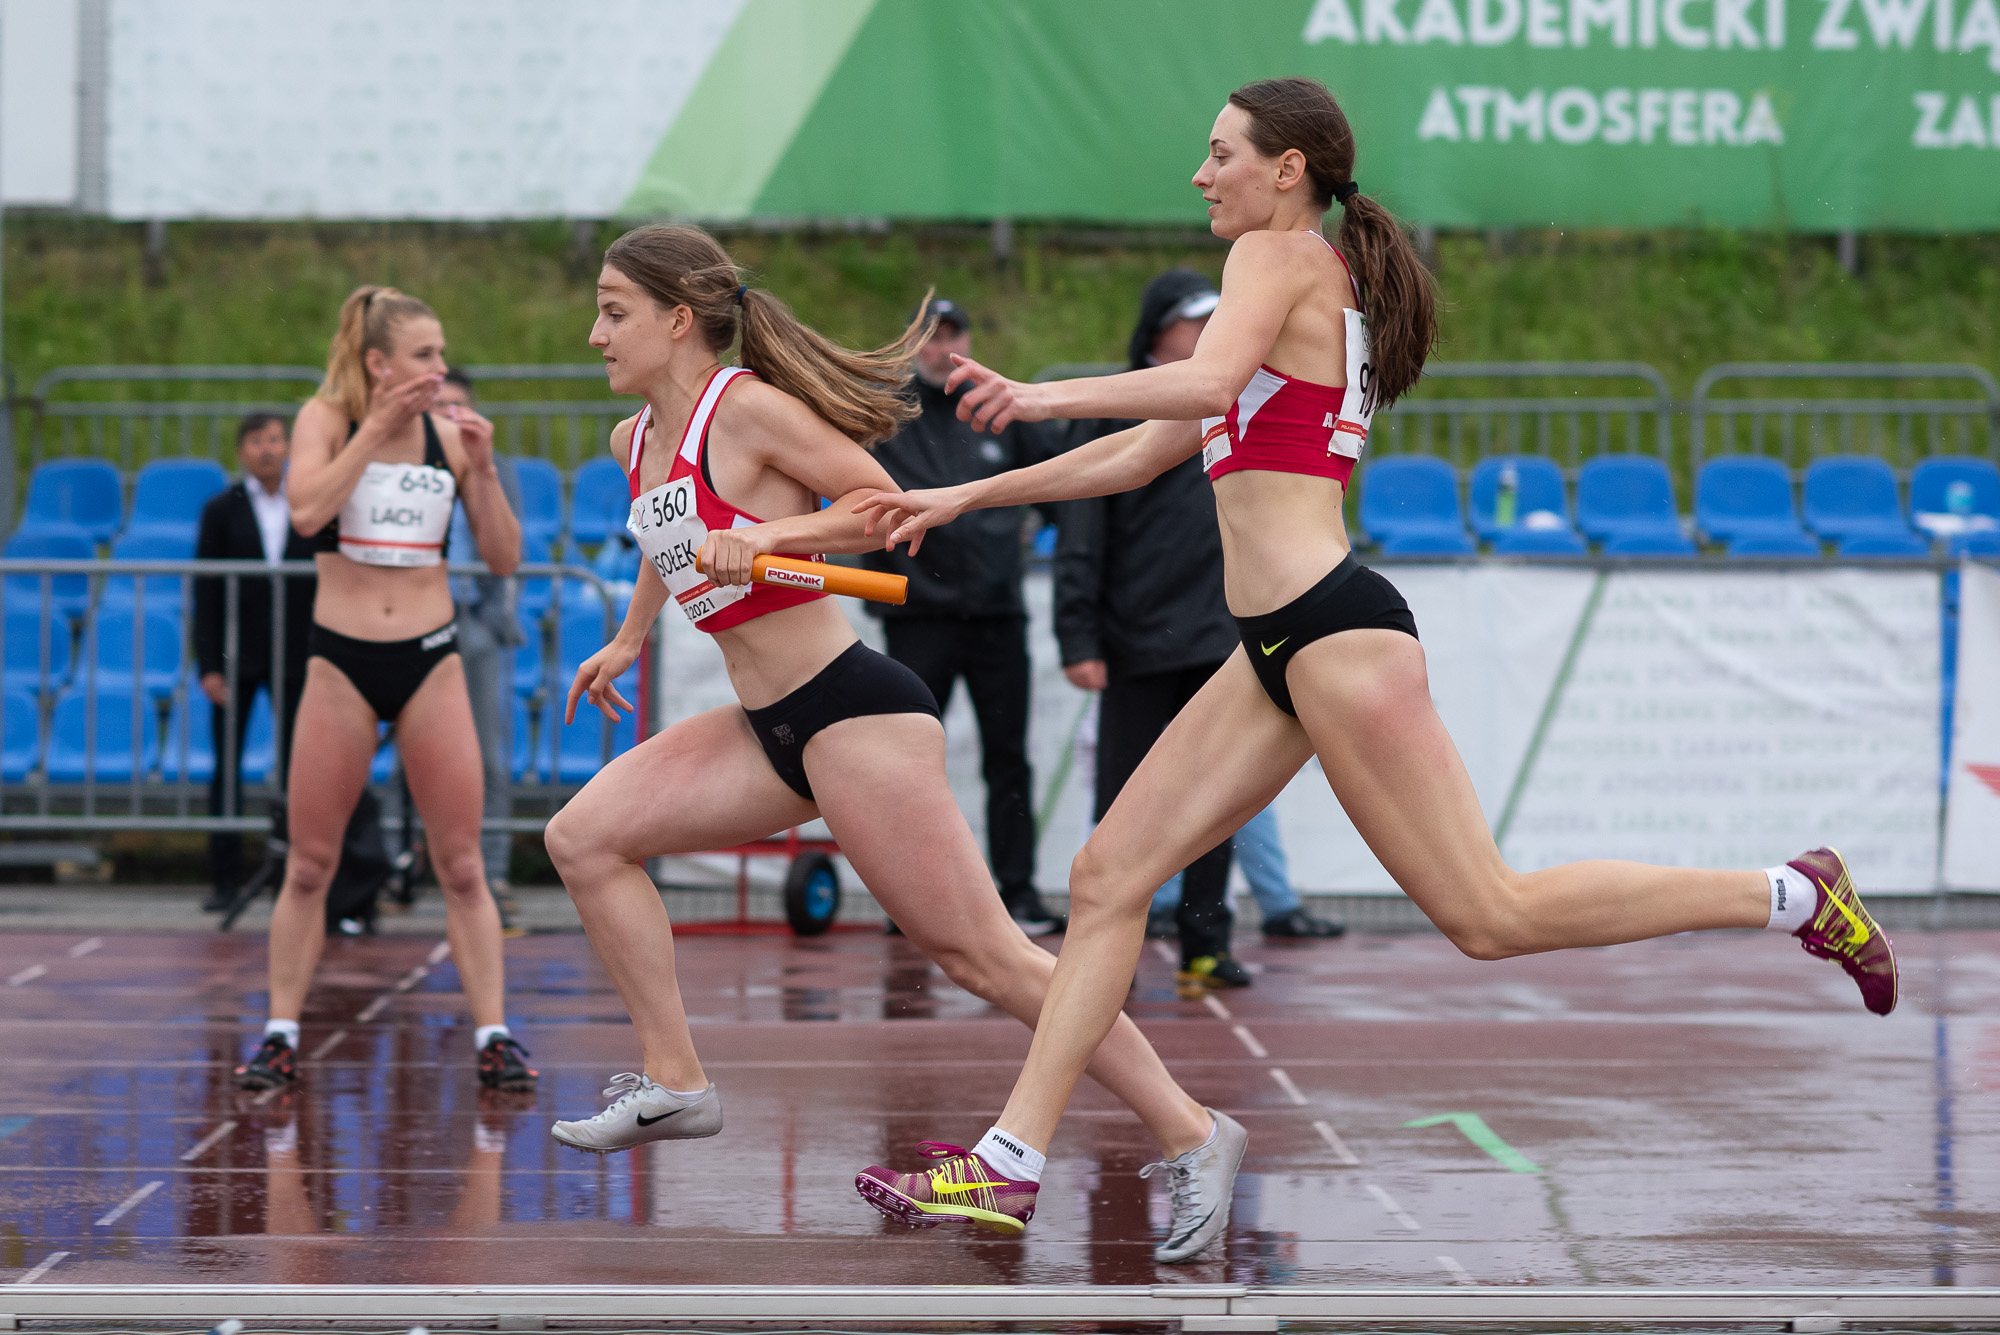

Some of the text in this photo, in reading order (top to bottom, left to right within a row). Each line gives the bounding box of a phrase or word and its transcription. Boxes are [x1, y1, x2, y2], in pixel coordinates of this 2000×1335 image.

[1304, 0, 1787, 48] AKADEMICKI
[1417, 86, 2000, 149] ATMOSFERA ZA
[399, 470, 445, 494] 645
[370, 506, 424, 527] LACH
[652, 486, 688, 528] 560
[767, 569, 821, 587] POLANIK
[688, 597, 716, 620] 2021
[991, 1133, 1025, 1159] PUMA
